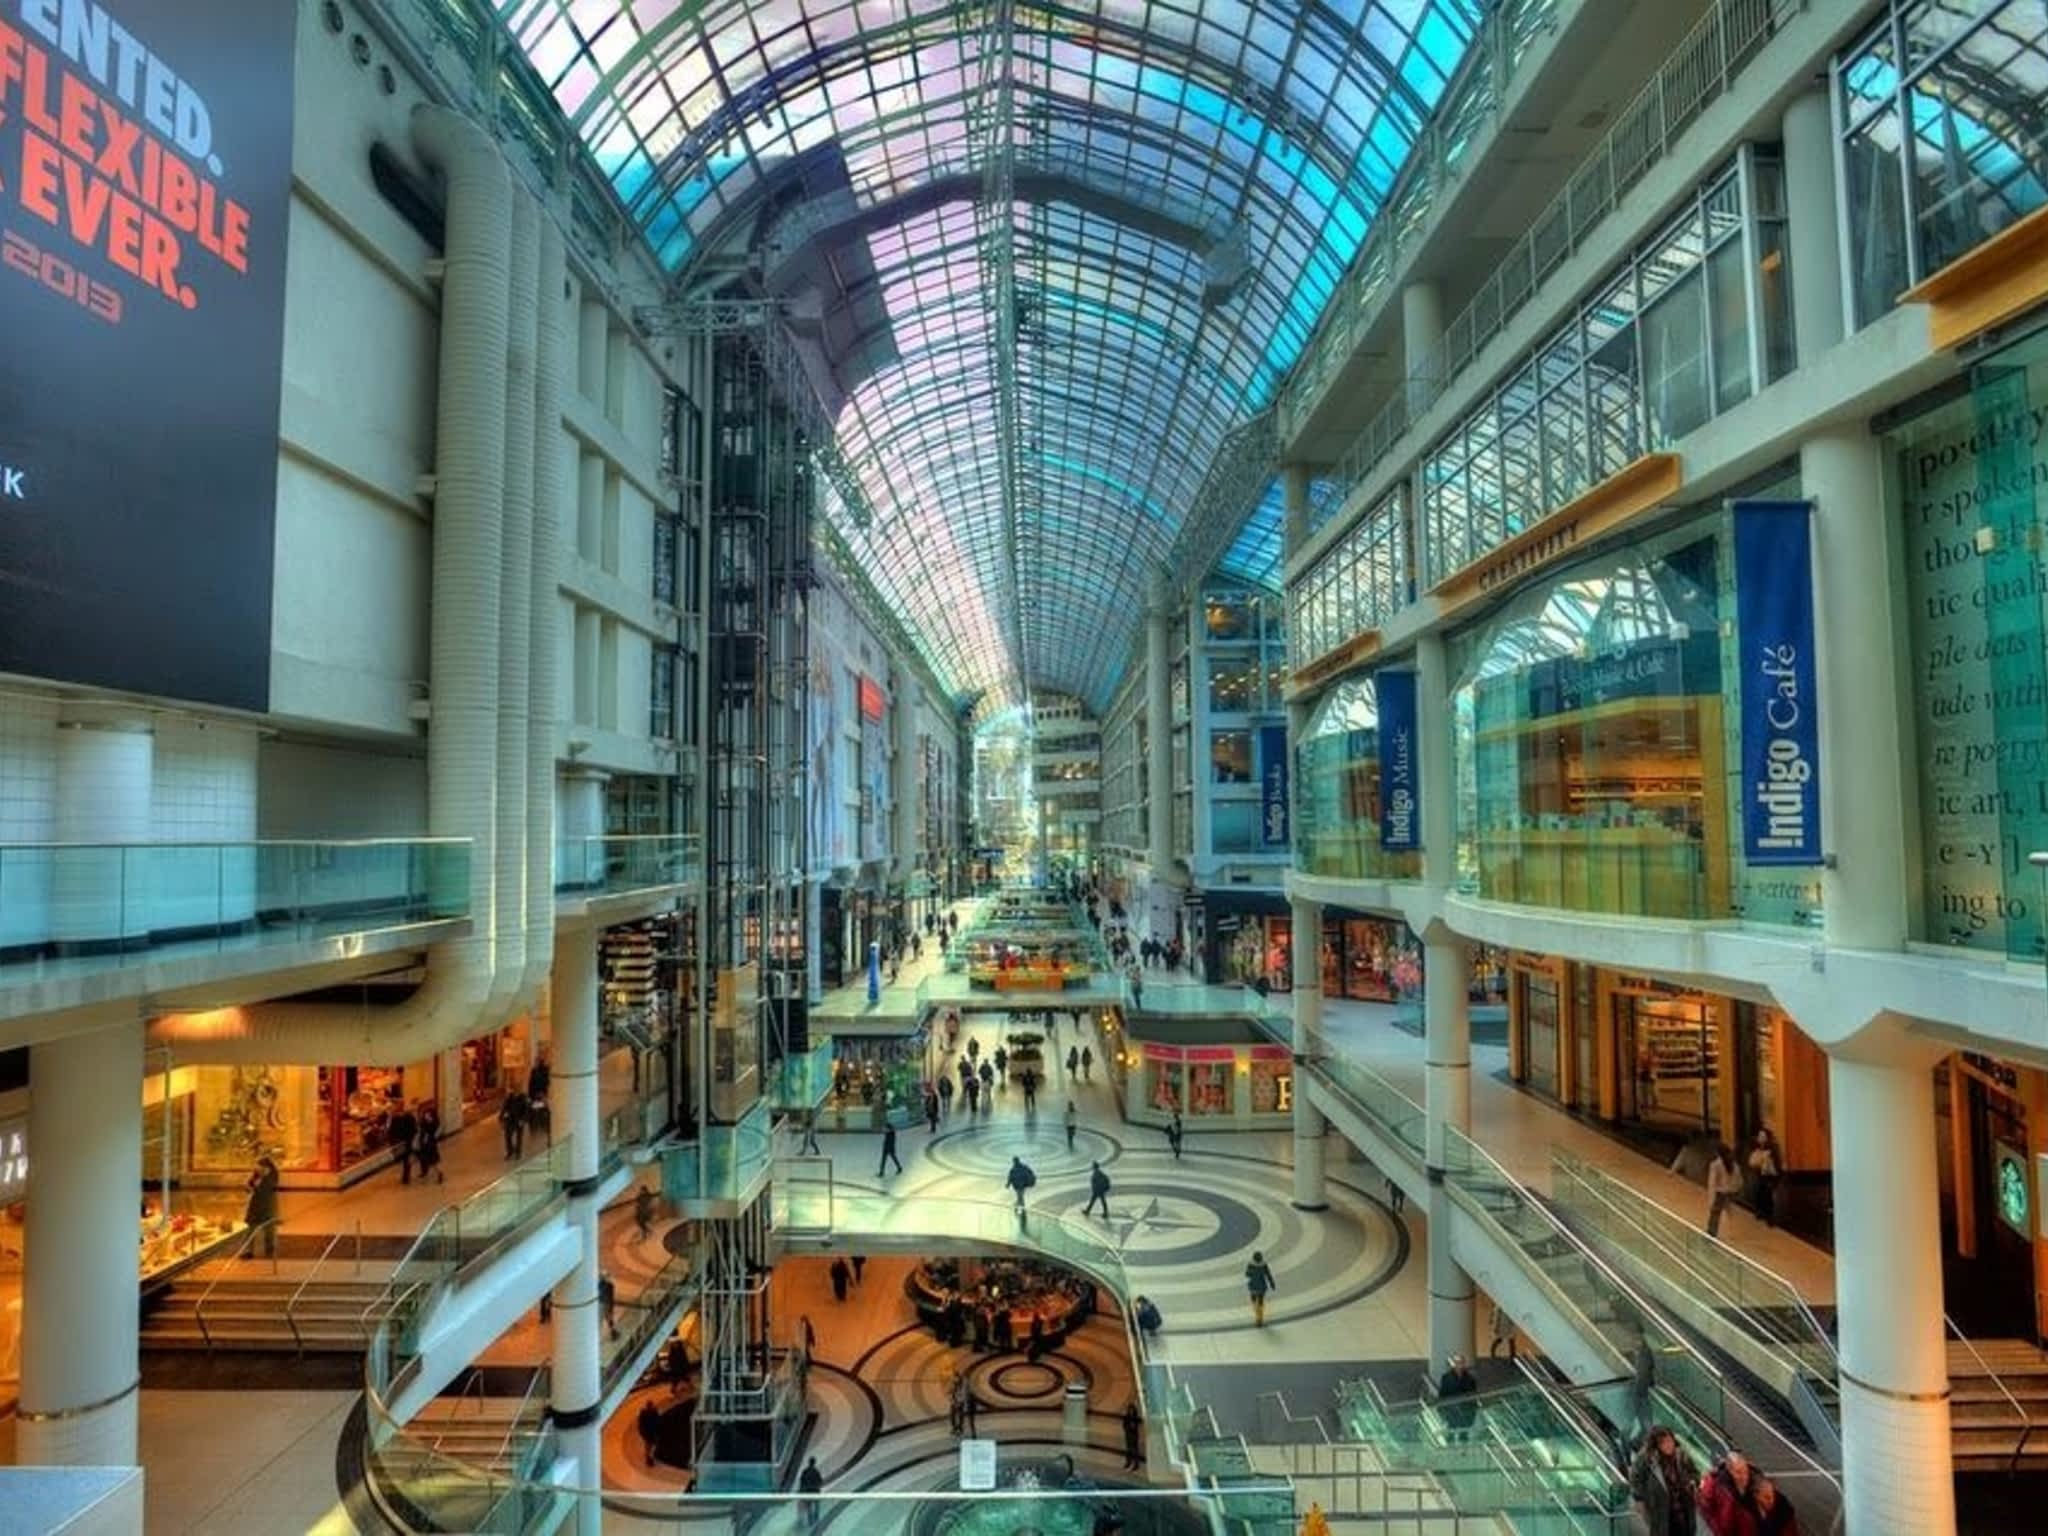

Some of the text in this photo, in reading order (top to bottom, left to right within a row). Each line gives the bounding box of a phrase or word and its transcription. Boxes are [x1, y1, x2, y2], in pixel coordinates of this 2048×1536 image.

[0, 19, 249, 273] FLEXIBLE
[20, 130, 197, 310] EVER.
[3, 228, 122, 324] 2013
[1762, 644, 1799, 730] Café
[1387, 788, 1414, 844] Indigo
[1757, 739, 1811, 848] Indigo
[1942, 885, 2027, 929] ing to
